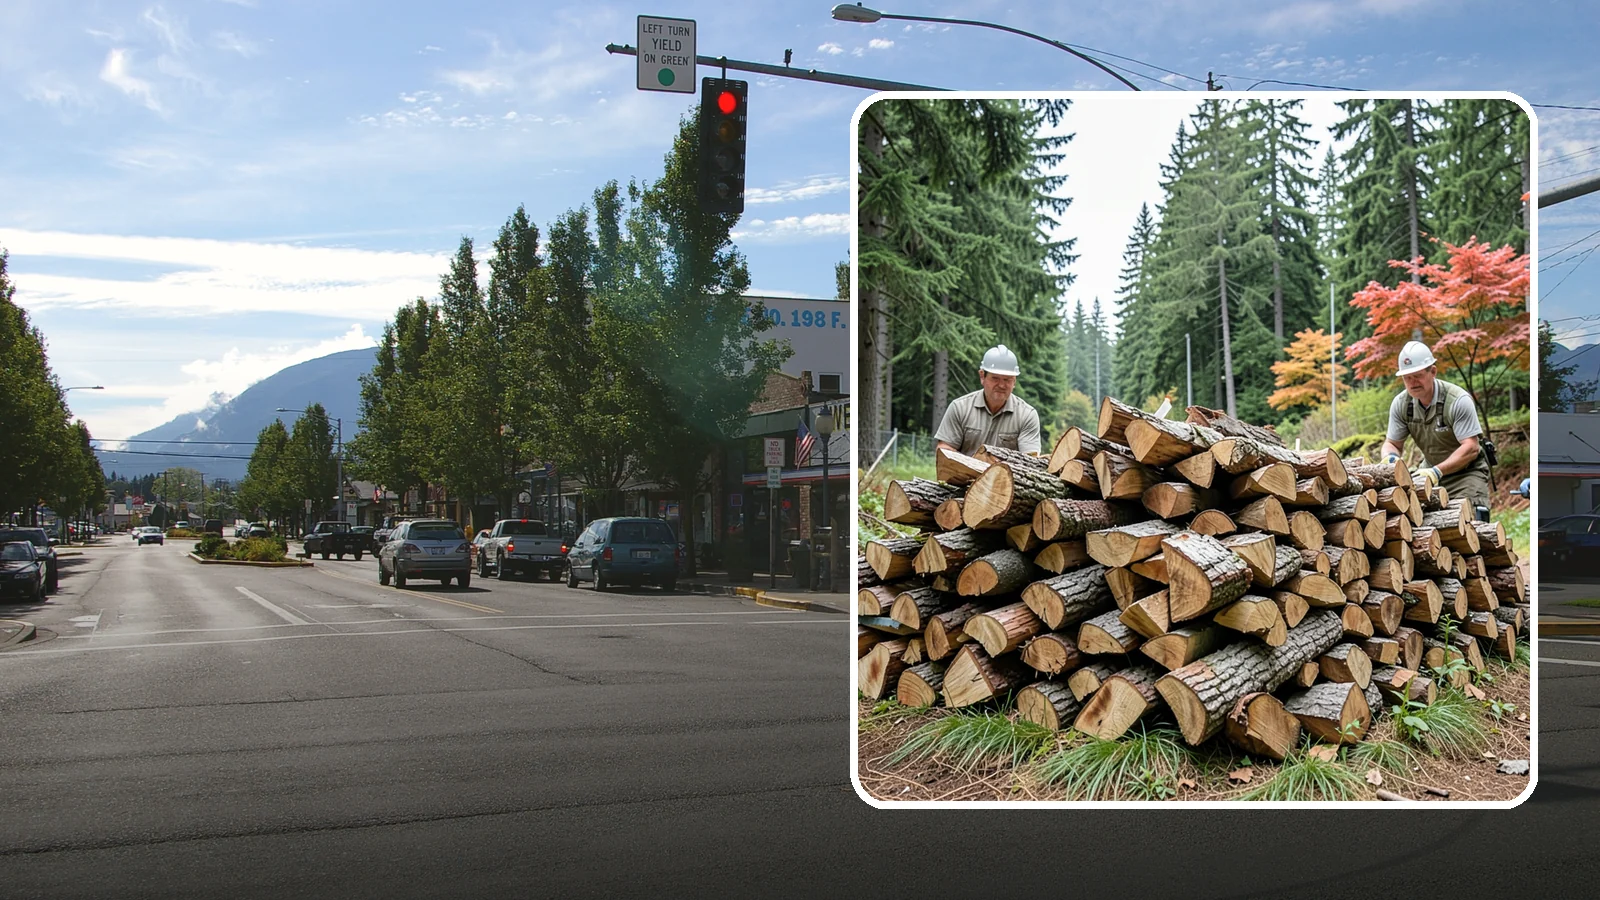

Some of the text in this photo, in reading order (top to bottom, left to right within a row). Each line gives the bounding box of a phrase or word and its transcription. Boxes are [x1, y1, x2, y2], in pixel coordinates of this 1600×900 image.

[642, 23, 690, 37] LEFT TURN
[652, 37, 682, 52] YIELD
[644, 53, 689, 66] ON GREEN
[791, 309, 827, 328] 198
[831, 311, 847, 329] F.
